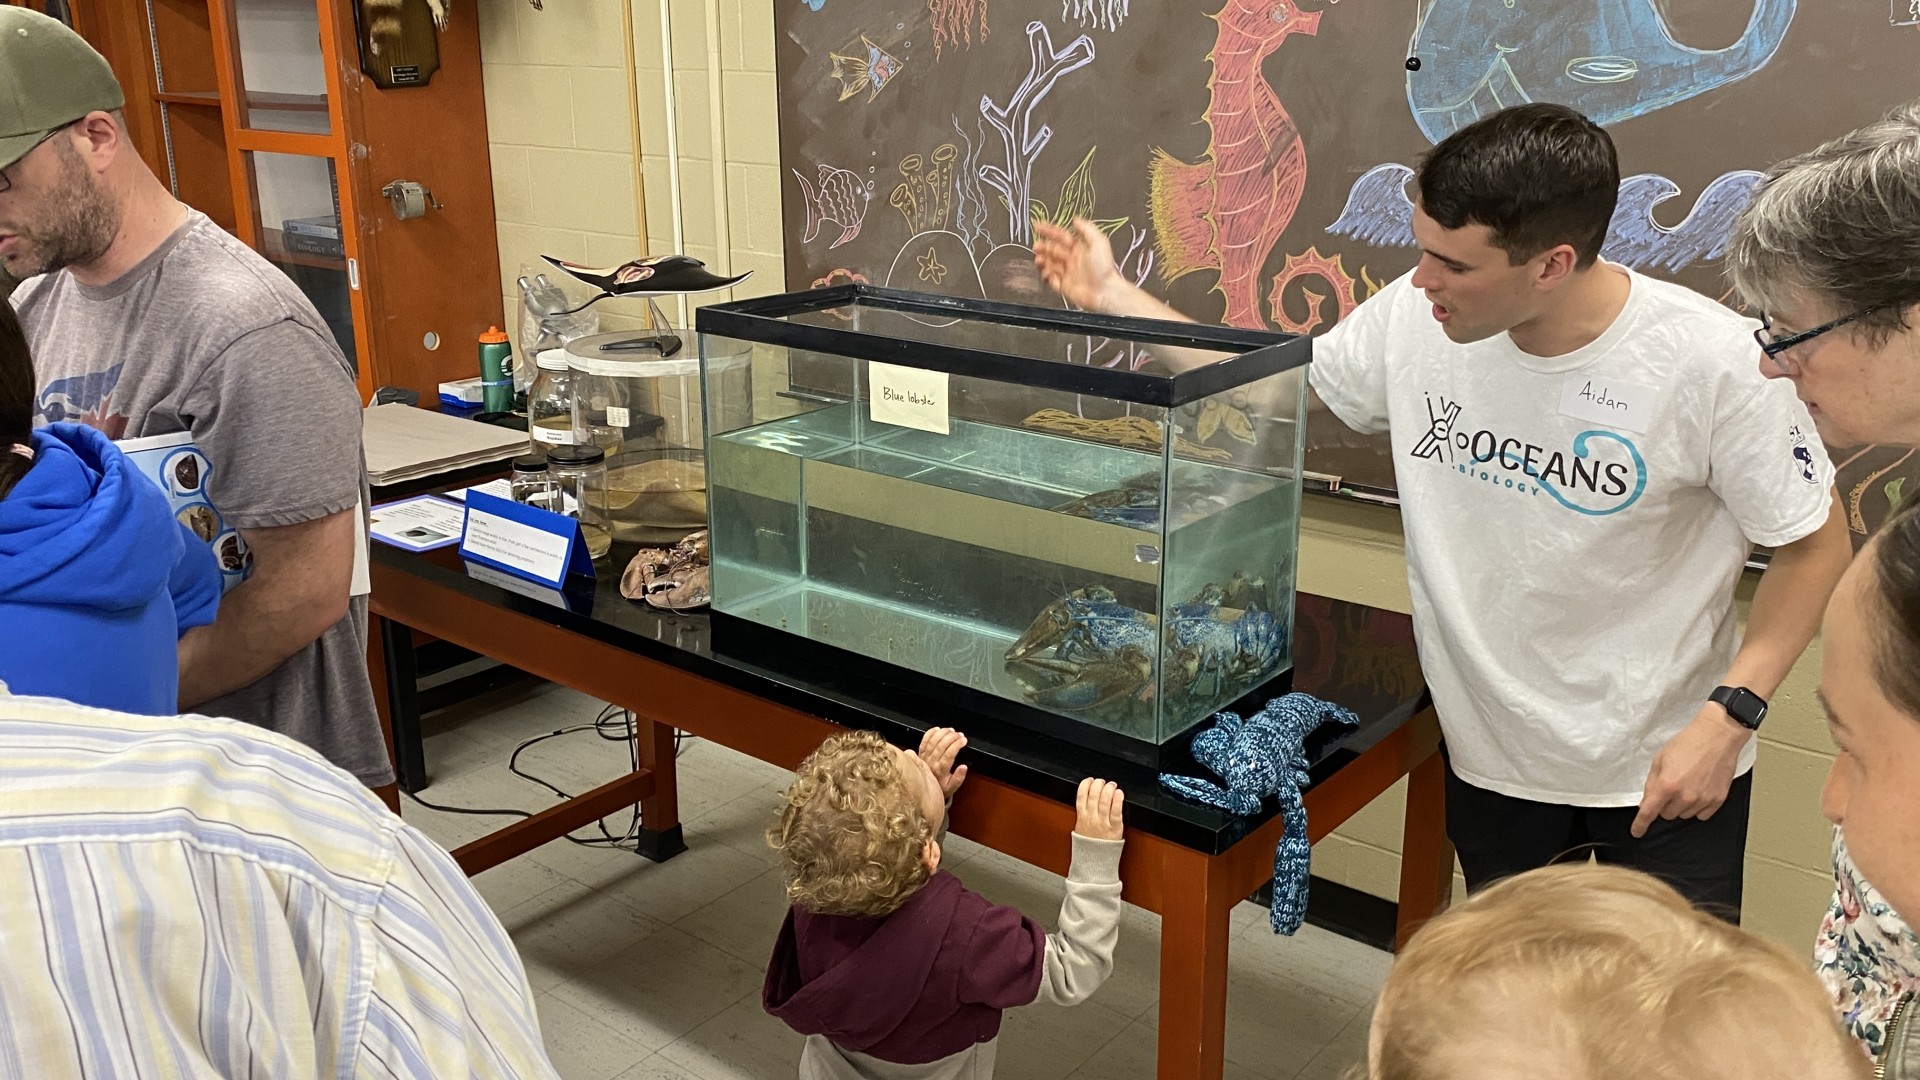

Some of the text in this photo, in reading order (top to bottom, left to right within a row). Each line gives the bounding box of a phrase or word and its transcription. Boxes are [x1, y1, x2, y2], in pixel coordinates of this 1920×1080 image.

[883, 385, 905, 403] Blue
[1578, 380, 1628, 412] Aidan
[1471, 429, 1628, 496] OCEANS
[1458, 463, 1540, 496] BIOLOGY
